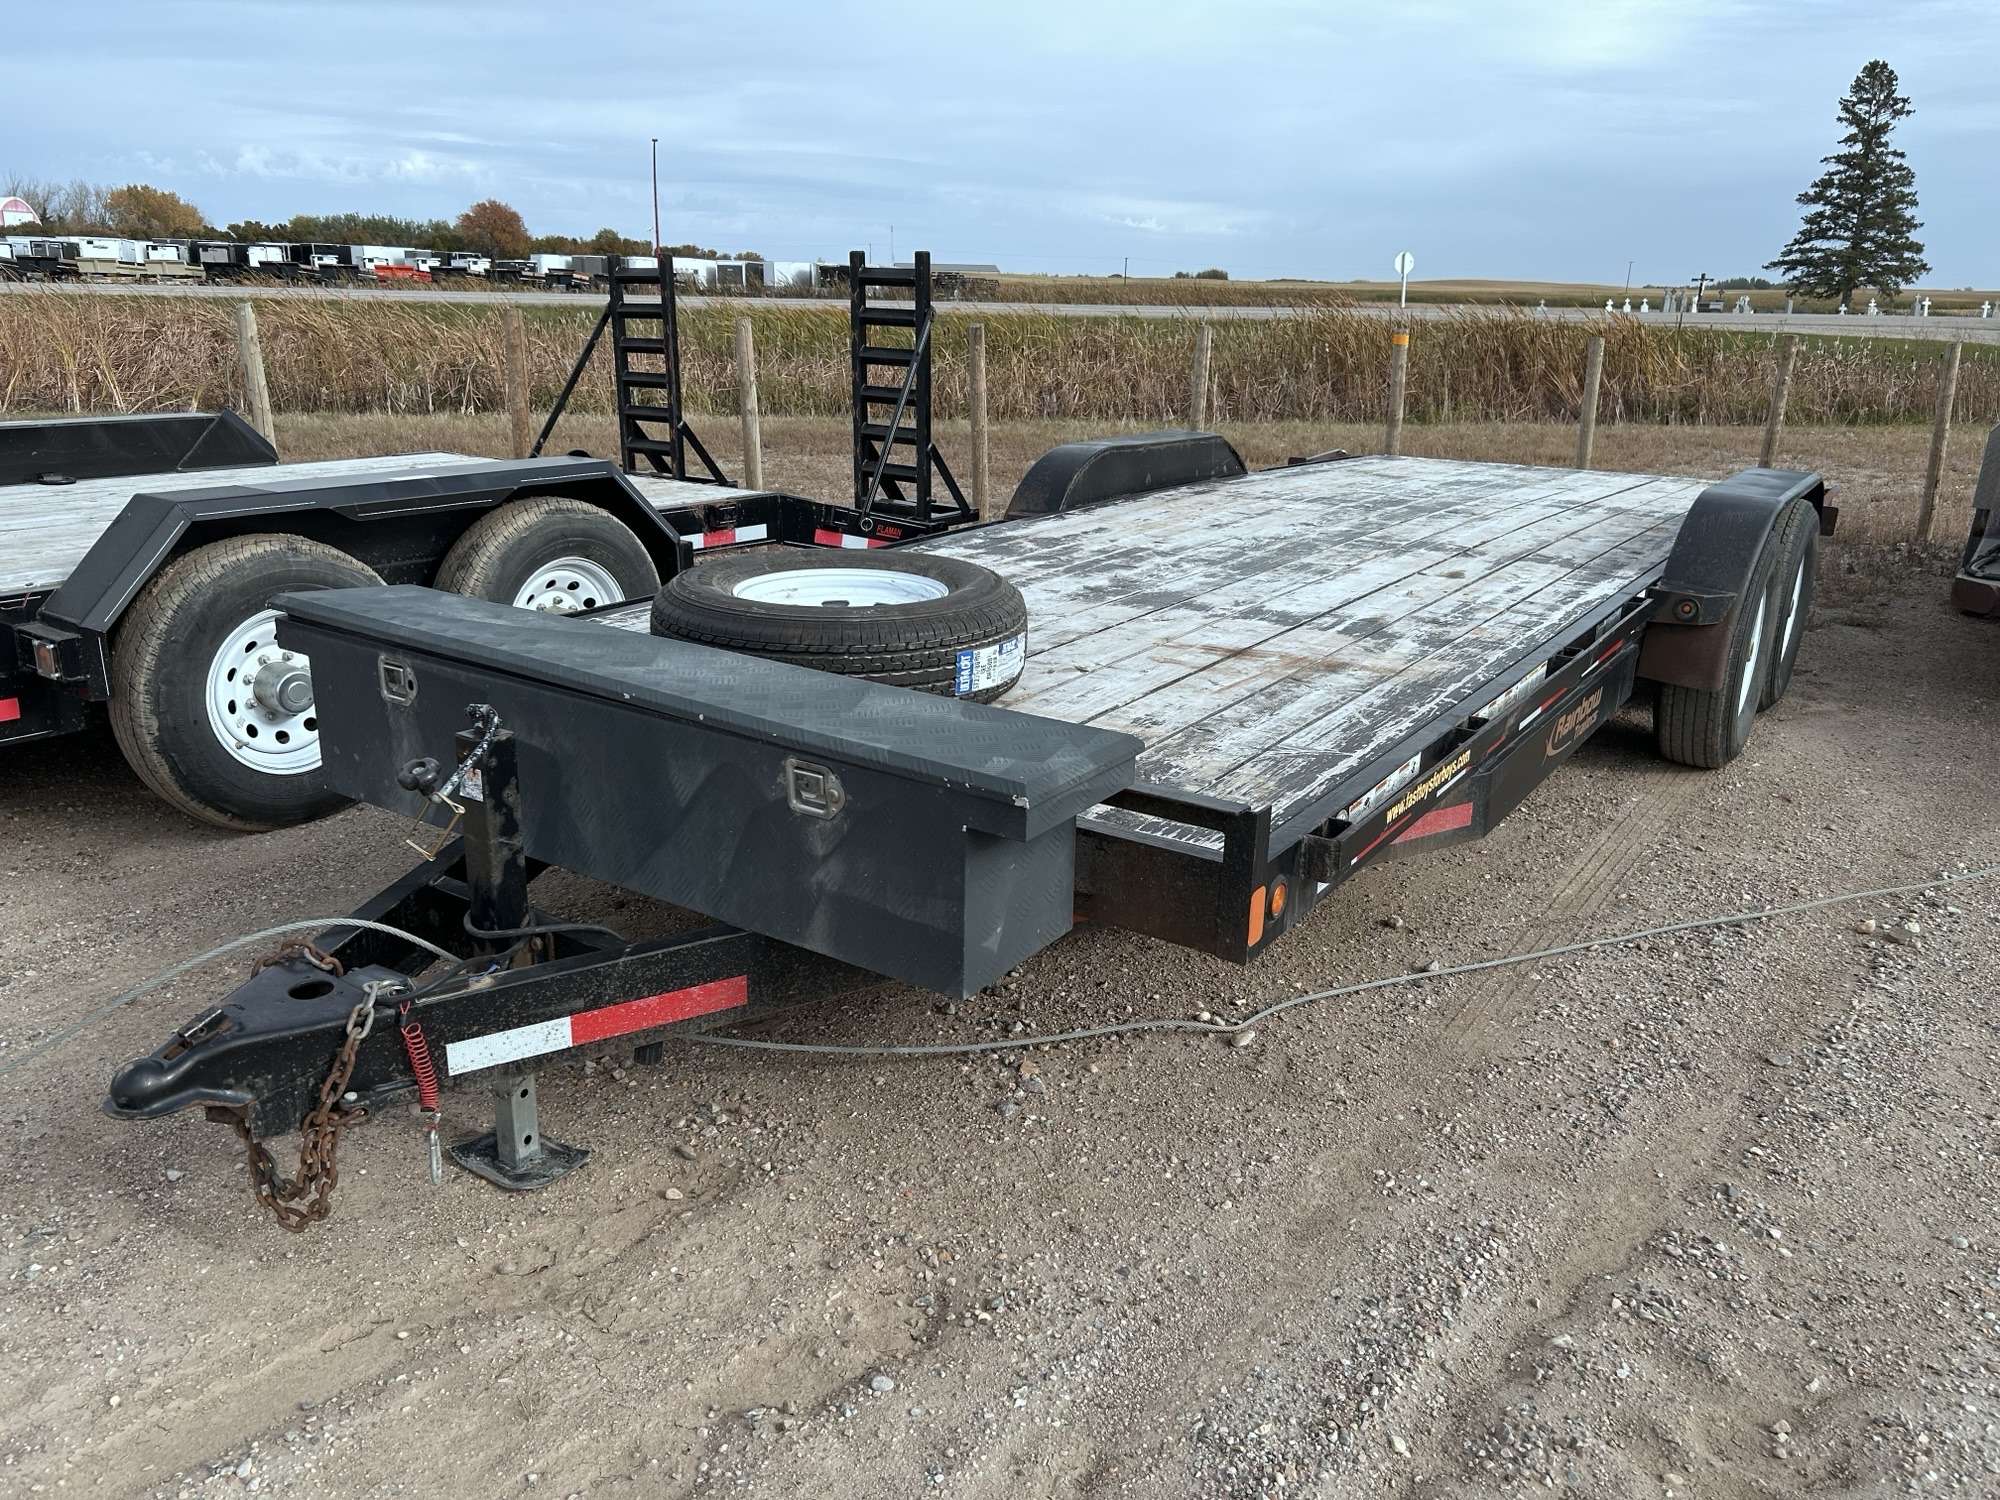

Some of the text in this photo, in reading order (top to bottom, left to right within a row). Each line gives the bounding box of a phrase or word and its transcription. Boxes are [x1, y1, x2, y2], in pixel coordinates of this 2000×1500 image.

[876, 524, 902, 536] FLAMAN
[1555, 686, 1603, 744] Rainbow
[1386, 749, 1471, 824] www.fasttoysforboys.com
